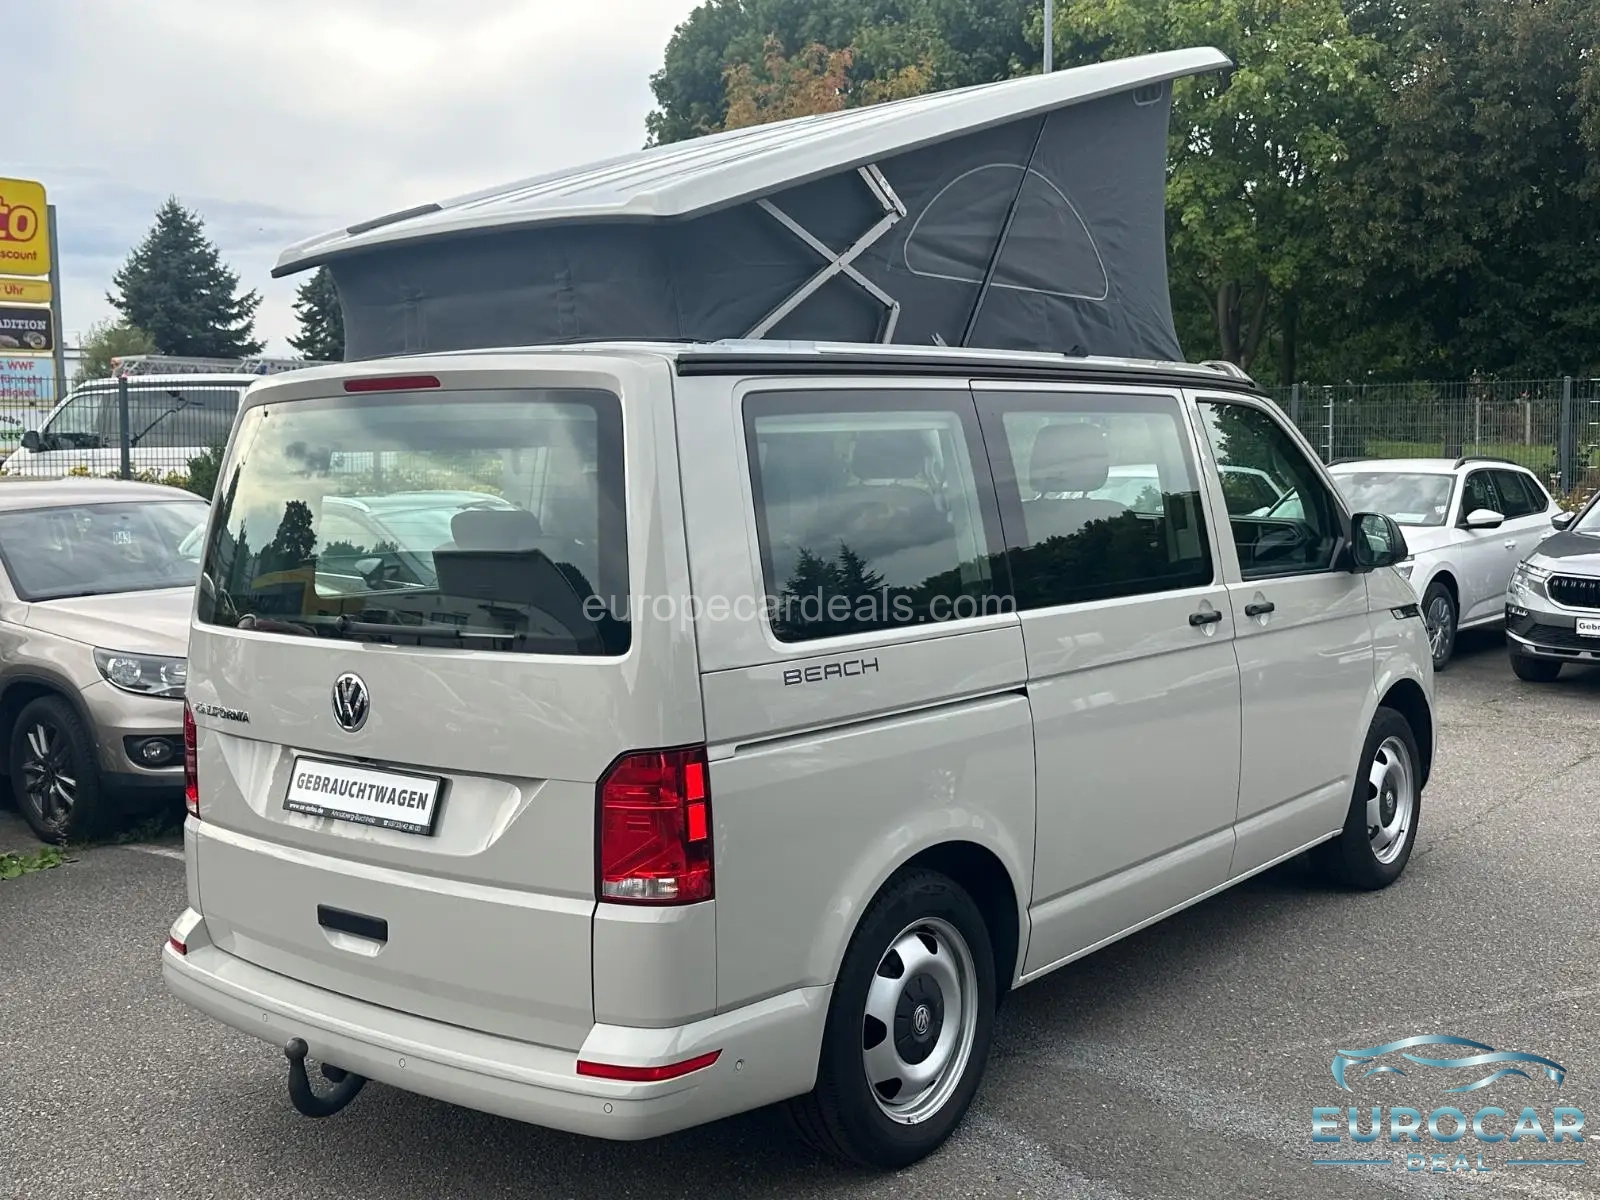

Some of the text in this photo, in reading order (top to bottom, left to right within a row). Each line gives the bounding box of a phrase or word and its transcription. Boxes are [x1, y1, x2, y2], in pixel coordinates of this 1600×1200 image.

[4, 284, 24, 295] Uhr
[7, 360, 35, 370] WWF
[783, 657, 879, 686] BEACH
[296, 772, 429, 811] GEBRAUCHTWAGEN
